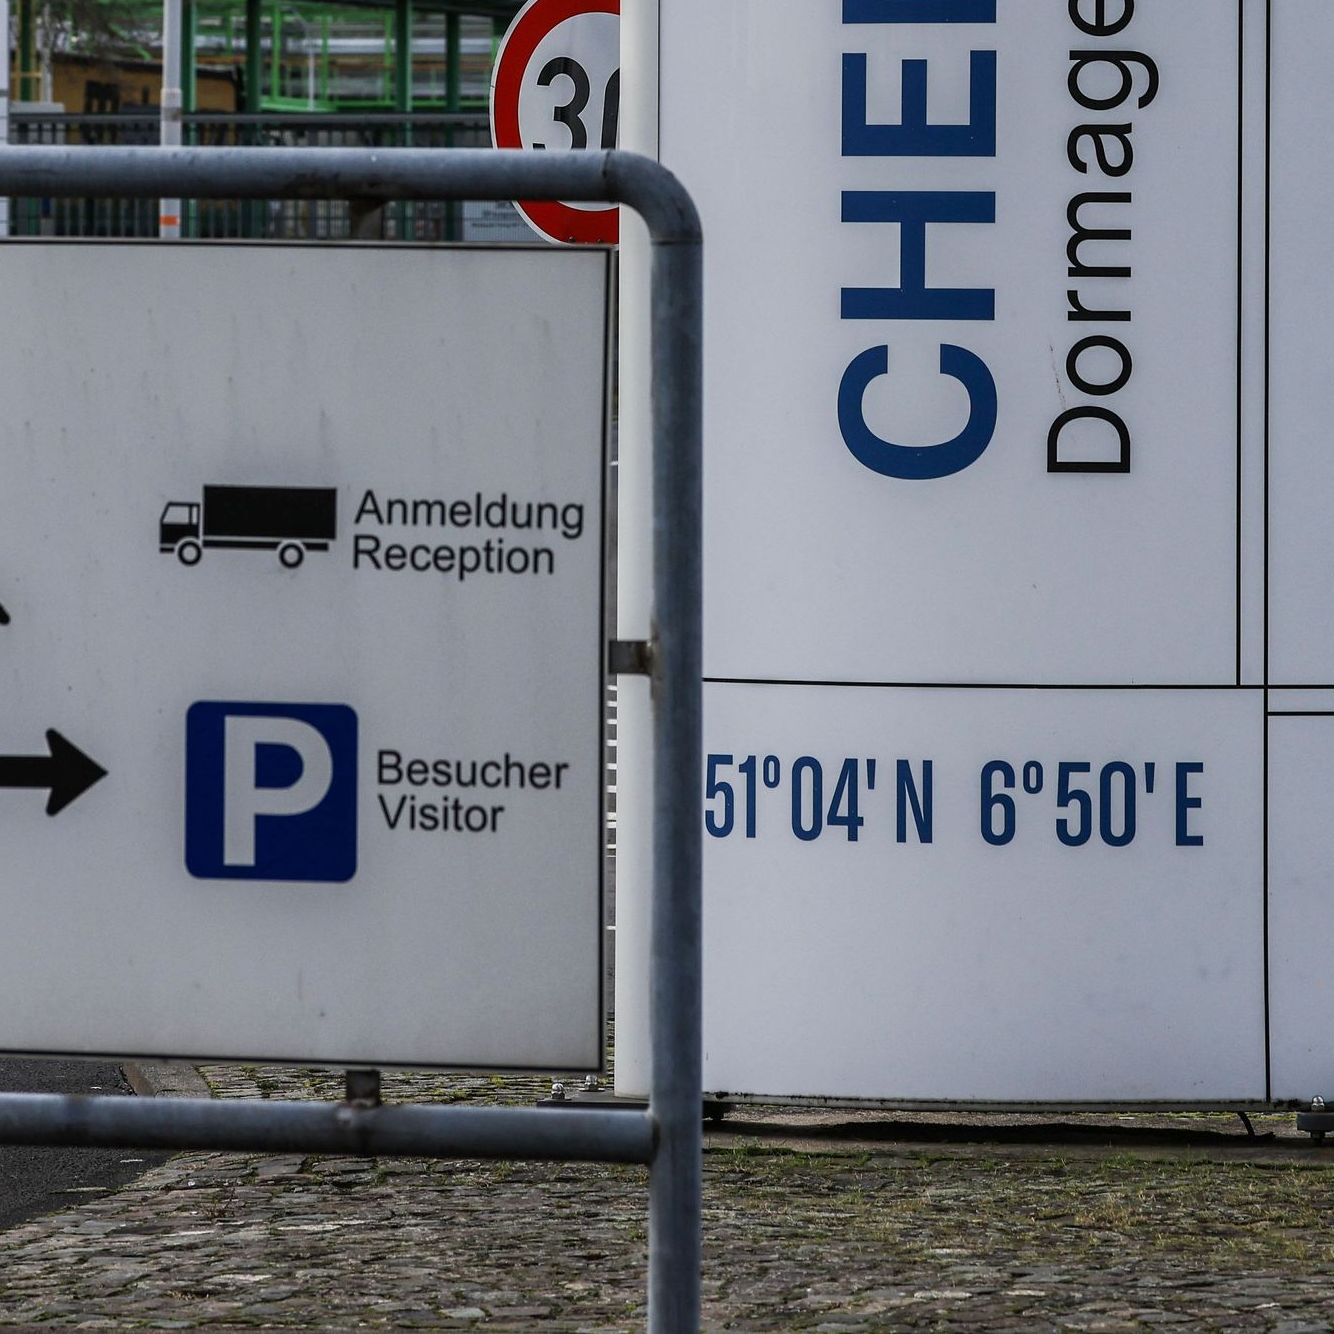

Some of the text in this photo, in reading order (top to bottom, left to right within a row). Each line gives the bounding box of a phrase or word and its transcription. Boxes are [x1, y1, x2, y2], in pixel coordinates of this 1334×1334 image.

[532, 56, 619, 150] 3
[354, 490, 585, 540] Anmeldung
[353, 534, 555, 581] Reception
[223, 714, 334, 866] P
[377, 750, 570, 790] Besucher
[377, 794, 505, 833] Visitor
